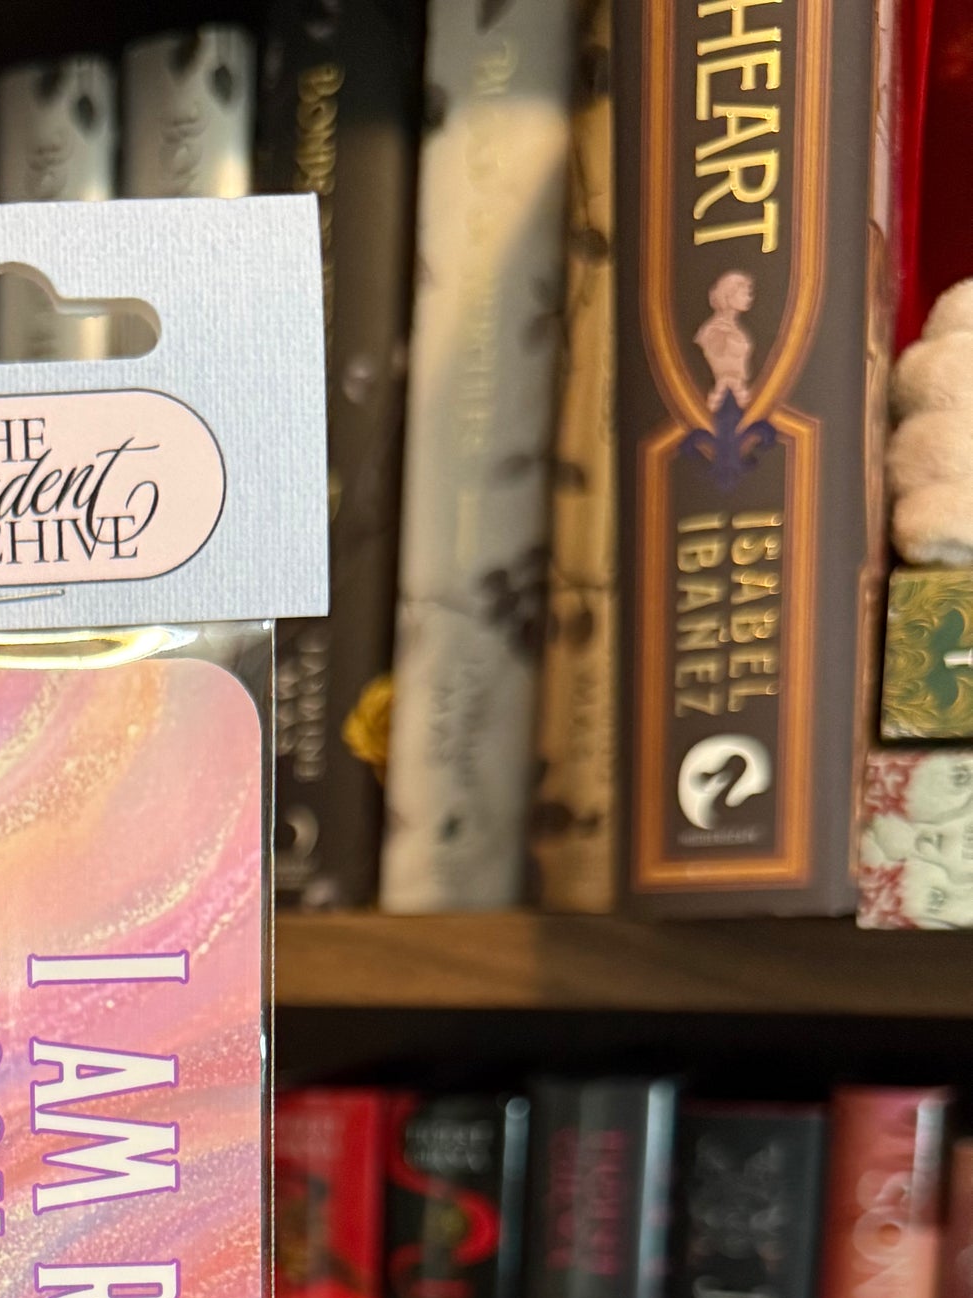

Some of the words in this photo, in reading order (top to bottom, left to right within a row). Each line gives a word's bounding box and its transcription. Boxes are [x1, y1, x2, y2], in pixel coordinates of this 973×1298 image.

[693, 0, 783, 254] HEART
[675, 510, 729, 718] IBAÑEZ
[728, 510, 783, 713] ISABEL
[27, 949, 190, 988] I
[29, 1035, 180, 1216] AM
